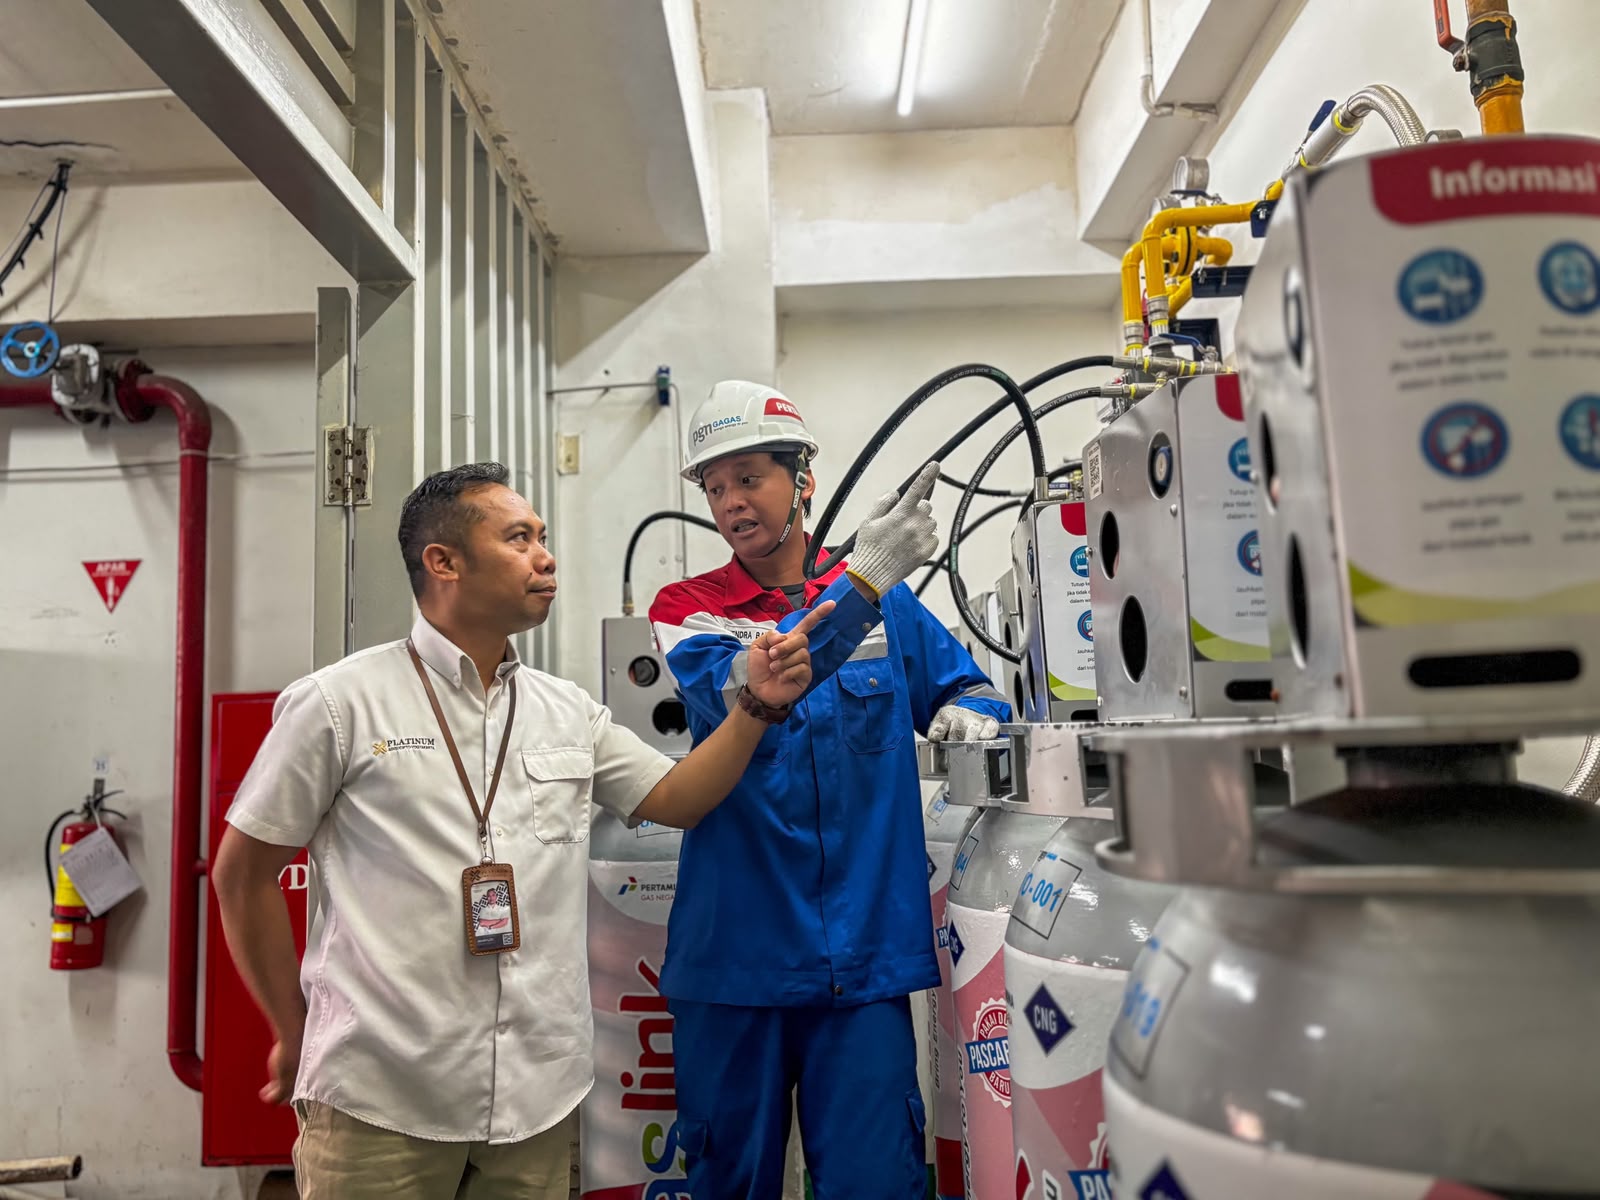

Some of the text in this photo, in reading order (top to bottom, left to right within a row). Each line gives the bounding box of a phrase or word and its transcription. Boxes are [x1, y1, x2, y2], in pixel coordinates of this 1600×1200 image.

[1430, 160, 1597, 200] Informasi
[712, 416, 742, 428] GAGAS
[692, 423, 713, 447] pgn
[387, 738, 435, 747] PLATINUM
[979, 1012, 997, 1038] PAKAI
[1033, 1004, 1058, 1035] CNG
[988, 1071, 1011, 1095] BARU
